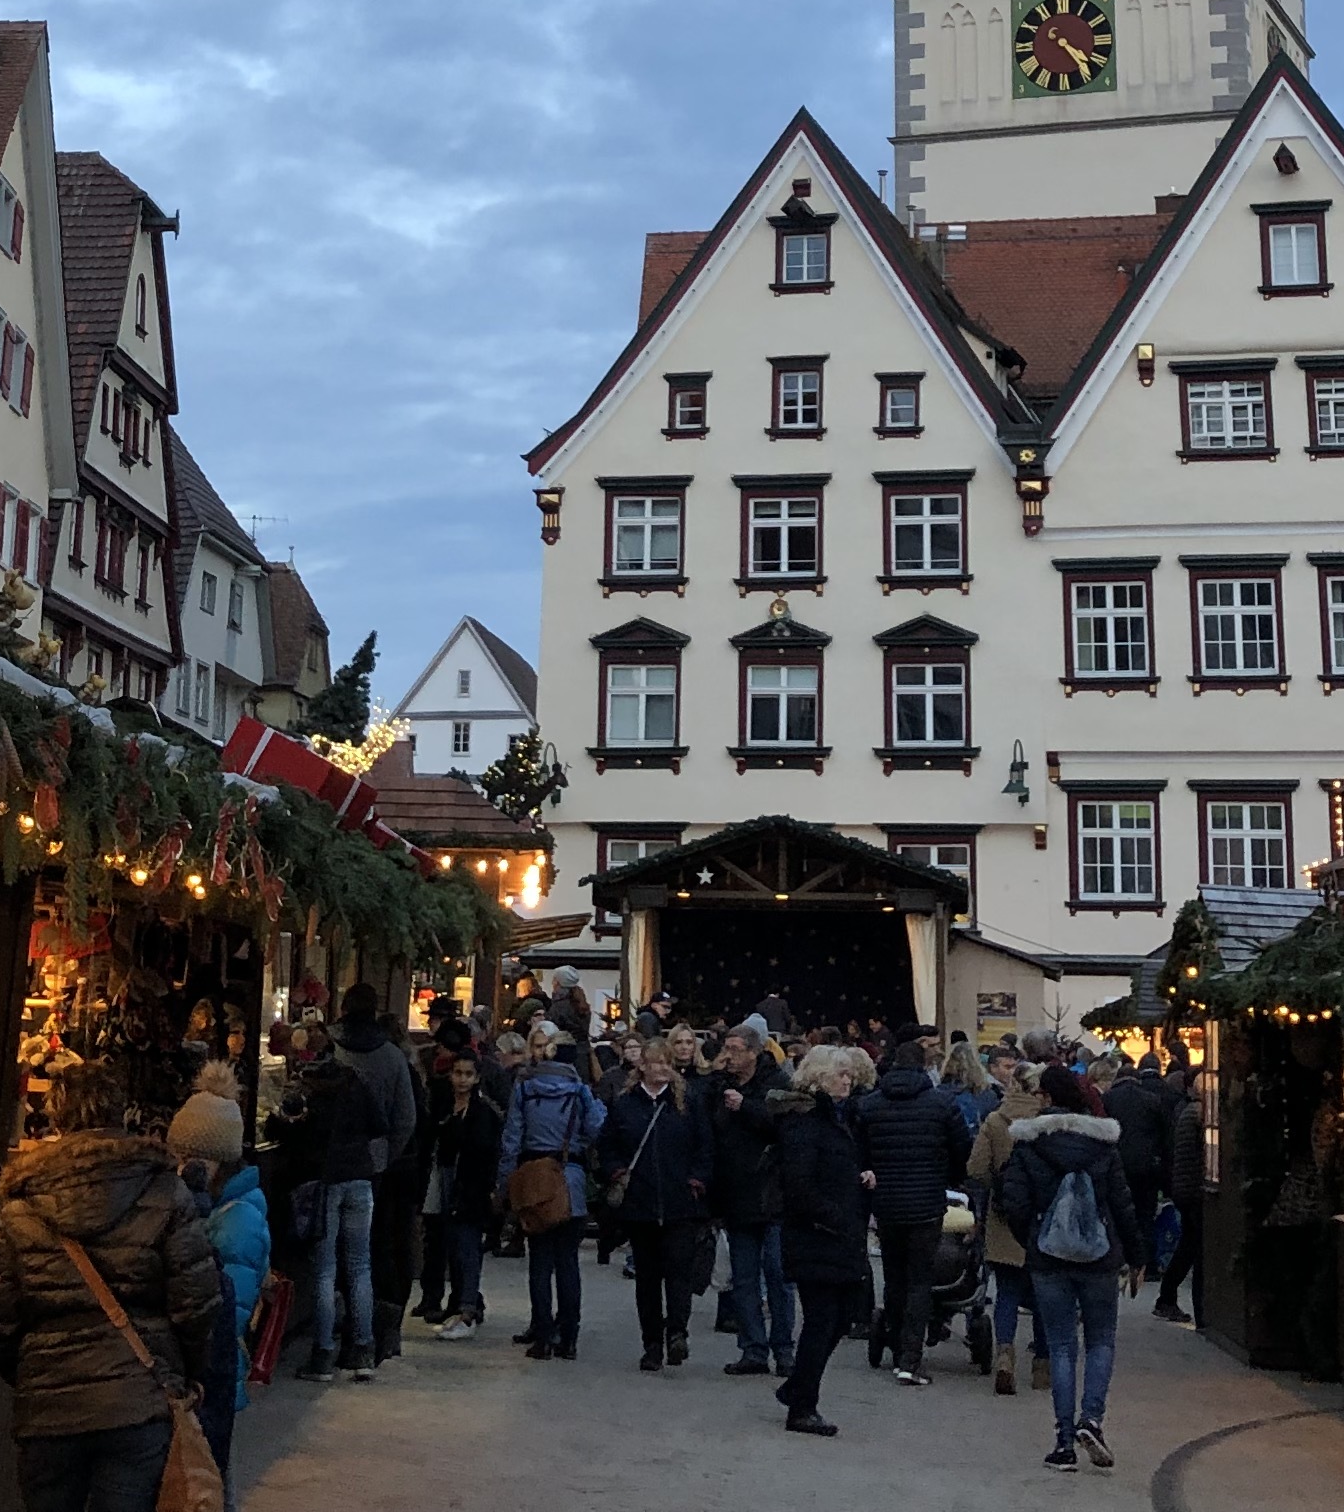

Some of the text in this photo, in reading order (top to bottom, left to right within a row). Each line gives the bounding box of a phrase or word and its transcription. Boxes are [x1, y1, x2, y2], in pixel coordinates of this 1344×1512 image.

[1035, 2, 1051, 22] XI
[1088, 13, 1105, 28] II
[1094, 33, 1111, 46] III
